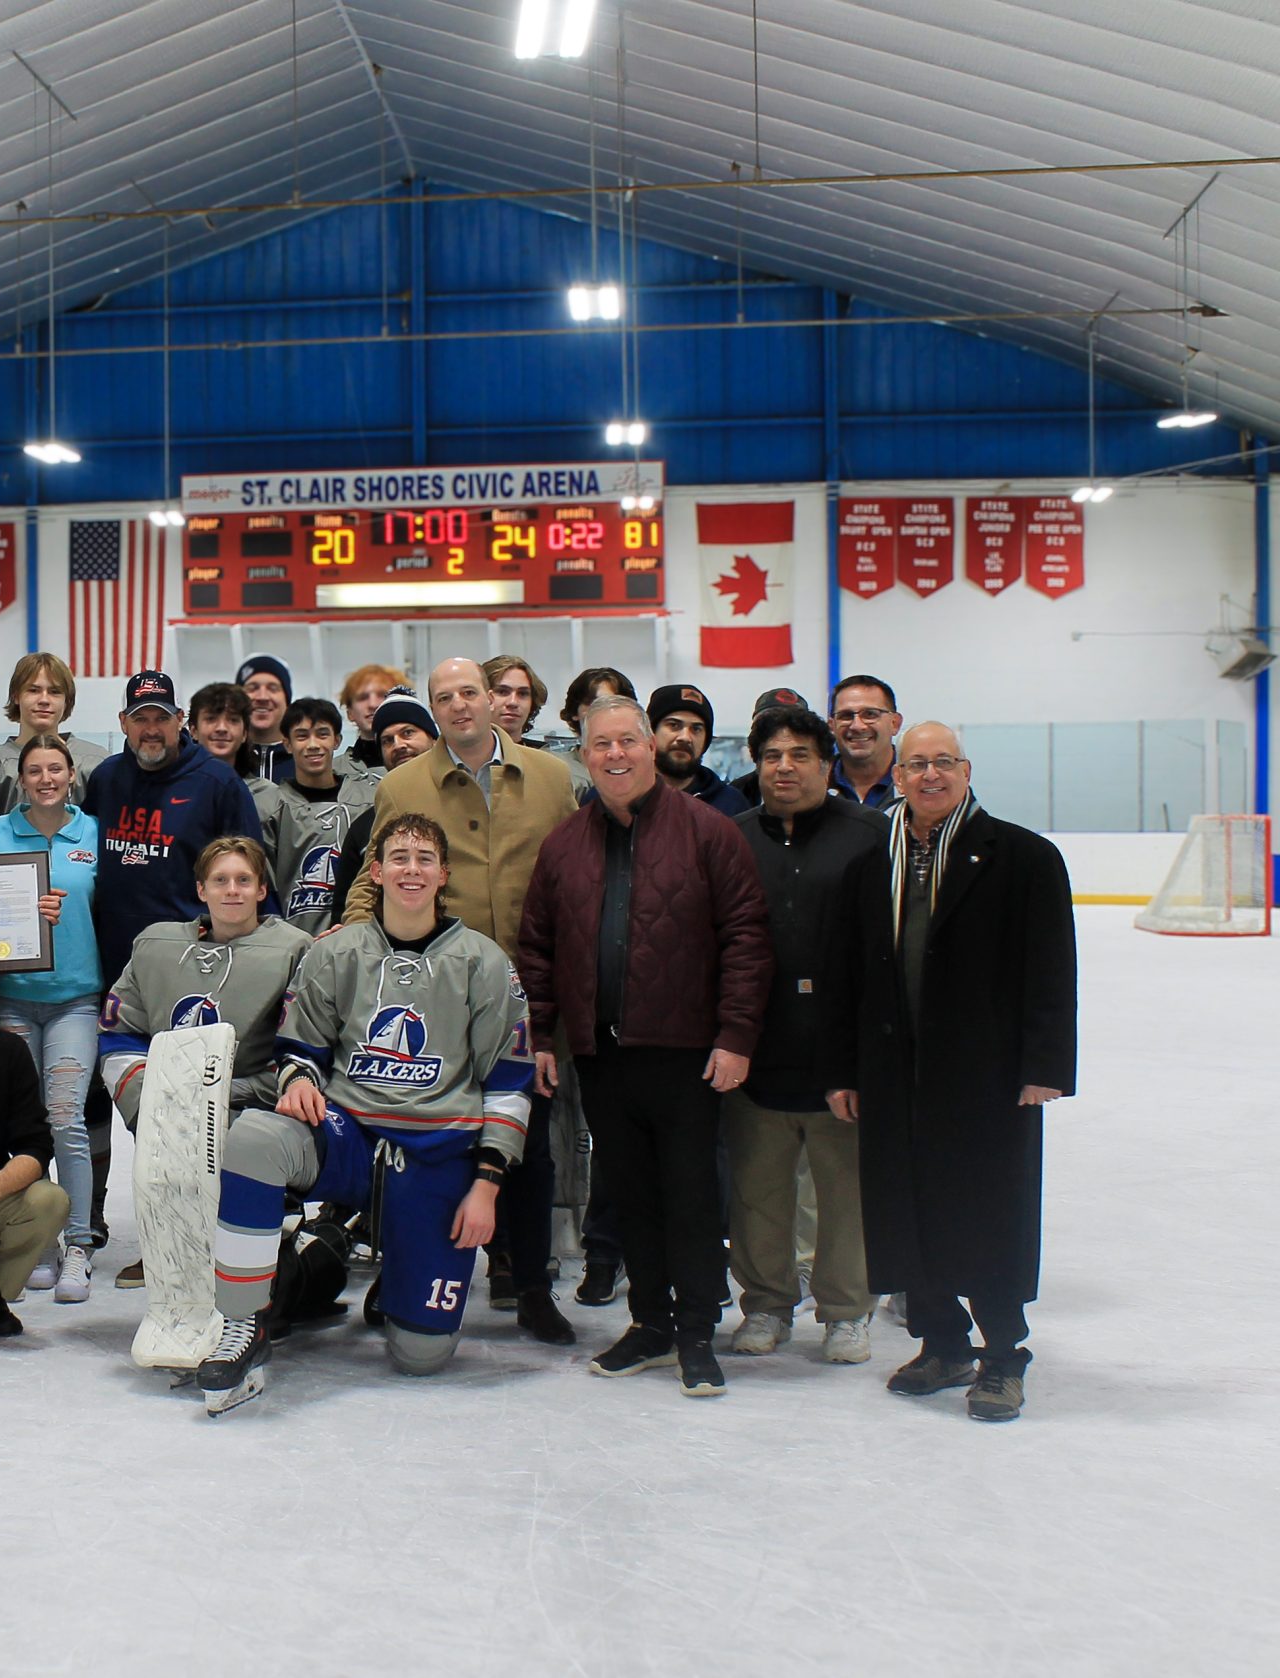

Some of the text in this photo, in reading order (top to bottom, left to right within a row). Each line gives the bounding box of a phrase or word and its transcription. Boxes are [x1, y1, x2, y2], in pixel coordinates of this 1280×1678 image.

[241, 479, 272, 506] ST.
[279, 477, 346, 504] CLAIR
[354, 474, 444, 502] SHORES
[452, 471, 513, 500] CIVIC
[522, 470, 600, 498] ARENA
[312, 529, 355, 565] 20
[491, 525, 536, 560] 24
[548, 522, 604, 549] 0:22
[624, 521, 658, 548] 81
[396, 555, 429, 570] period
[447, 548, 465, 575] 2
[119, 805, 162, 833] USA
[349, 1060, 437, 1081] LAKERS
[206, 1100, 216, 1176] WARRIOR
[424, 1278, 462, 1312] 15
